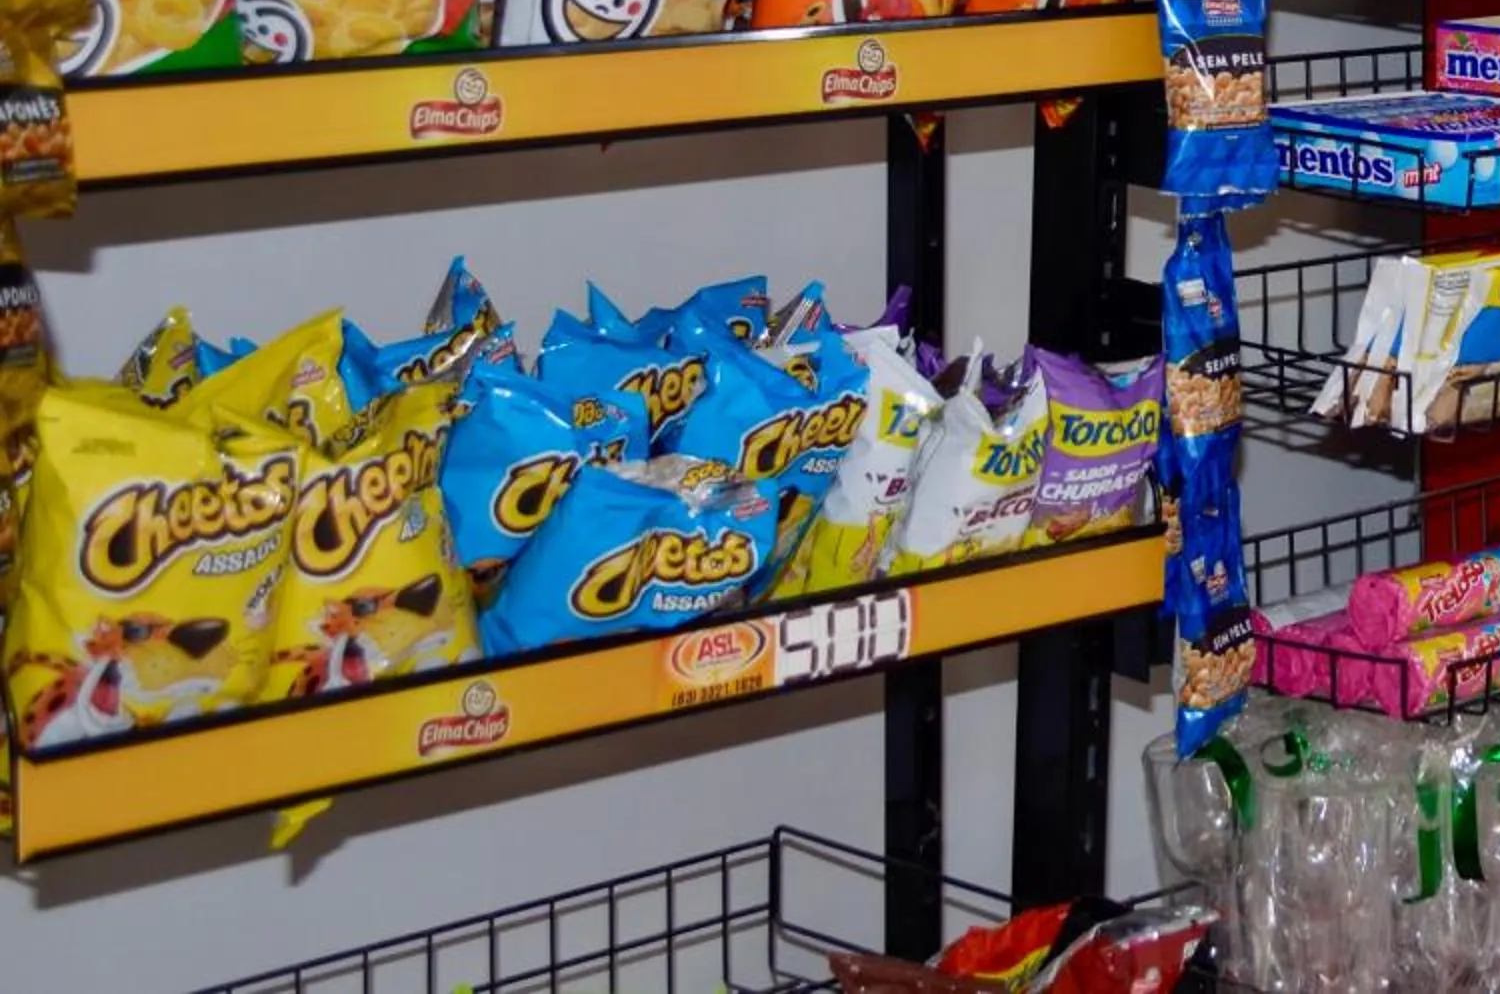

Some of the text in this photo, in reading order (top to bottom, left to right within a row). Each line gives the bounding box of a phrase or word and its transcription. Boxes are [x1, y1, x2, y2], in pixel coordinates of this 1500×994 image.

[1197, 51, 1264, 69] SEM PELE
[1403, 162, 1442, 188] mnt
[1064, 463, 1118, 482] SABOR
[80, 455, 296, 593] Cheetos
[697, 631, 742, 662] ASL
